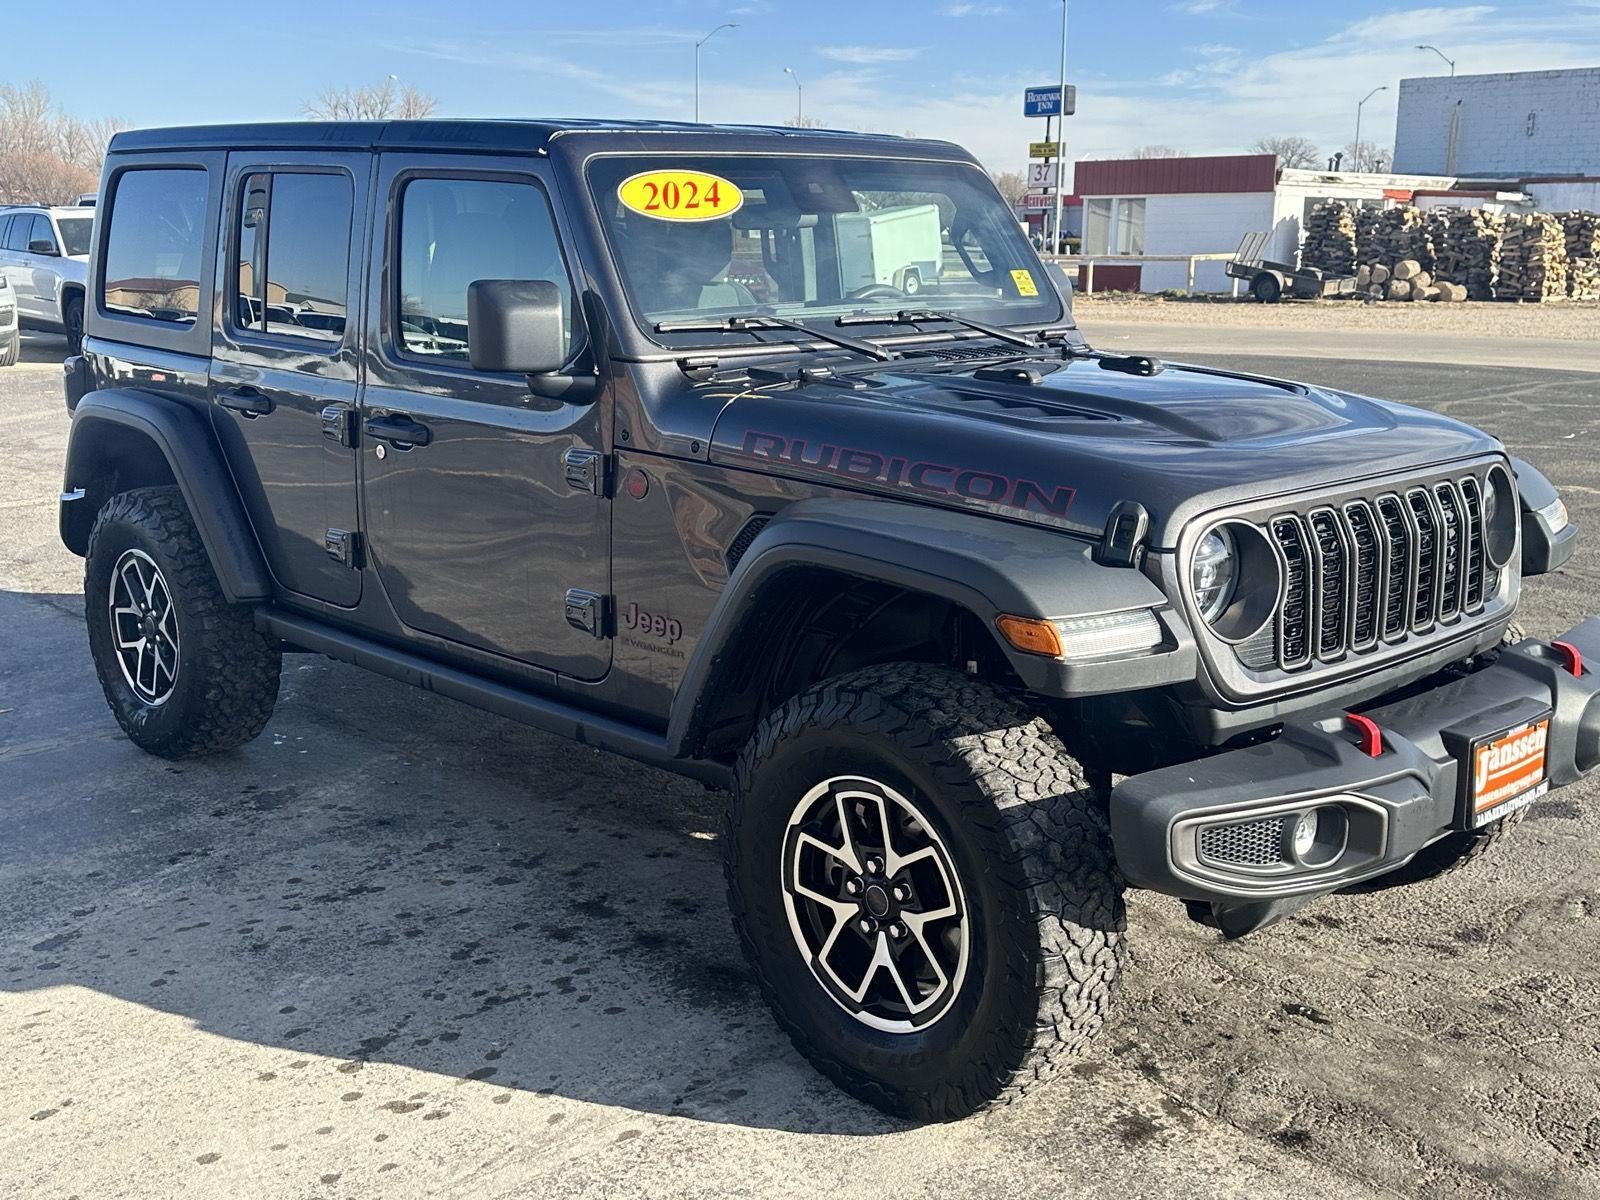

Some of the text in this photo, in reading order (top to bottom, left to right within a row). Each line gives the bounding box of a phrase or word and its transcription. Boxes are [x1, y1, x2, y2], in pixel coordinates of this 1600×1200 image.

[1026, 92, 1061, 103] RODEWA
[1037, 101, 1053, 112] INN
[1034, 164, 1051, 182] 37
[642, 181, 720, 210] 2024
[742, 430, 1077, 516] RUBICON
[621, 602, 682, 645] Jeep
[1476, 730, 1546, 793] Janssen
